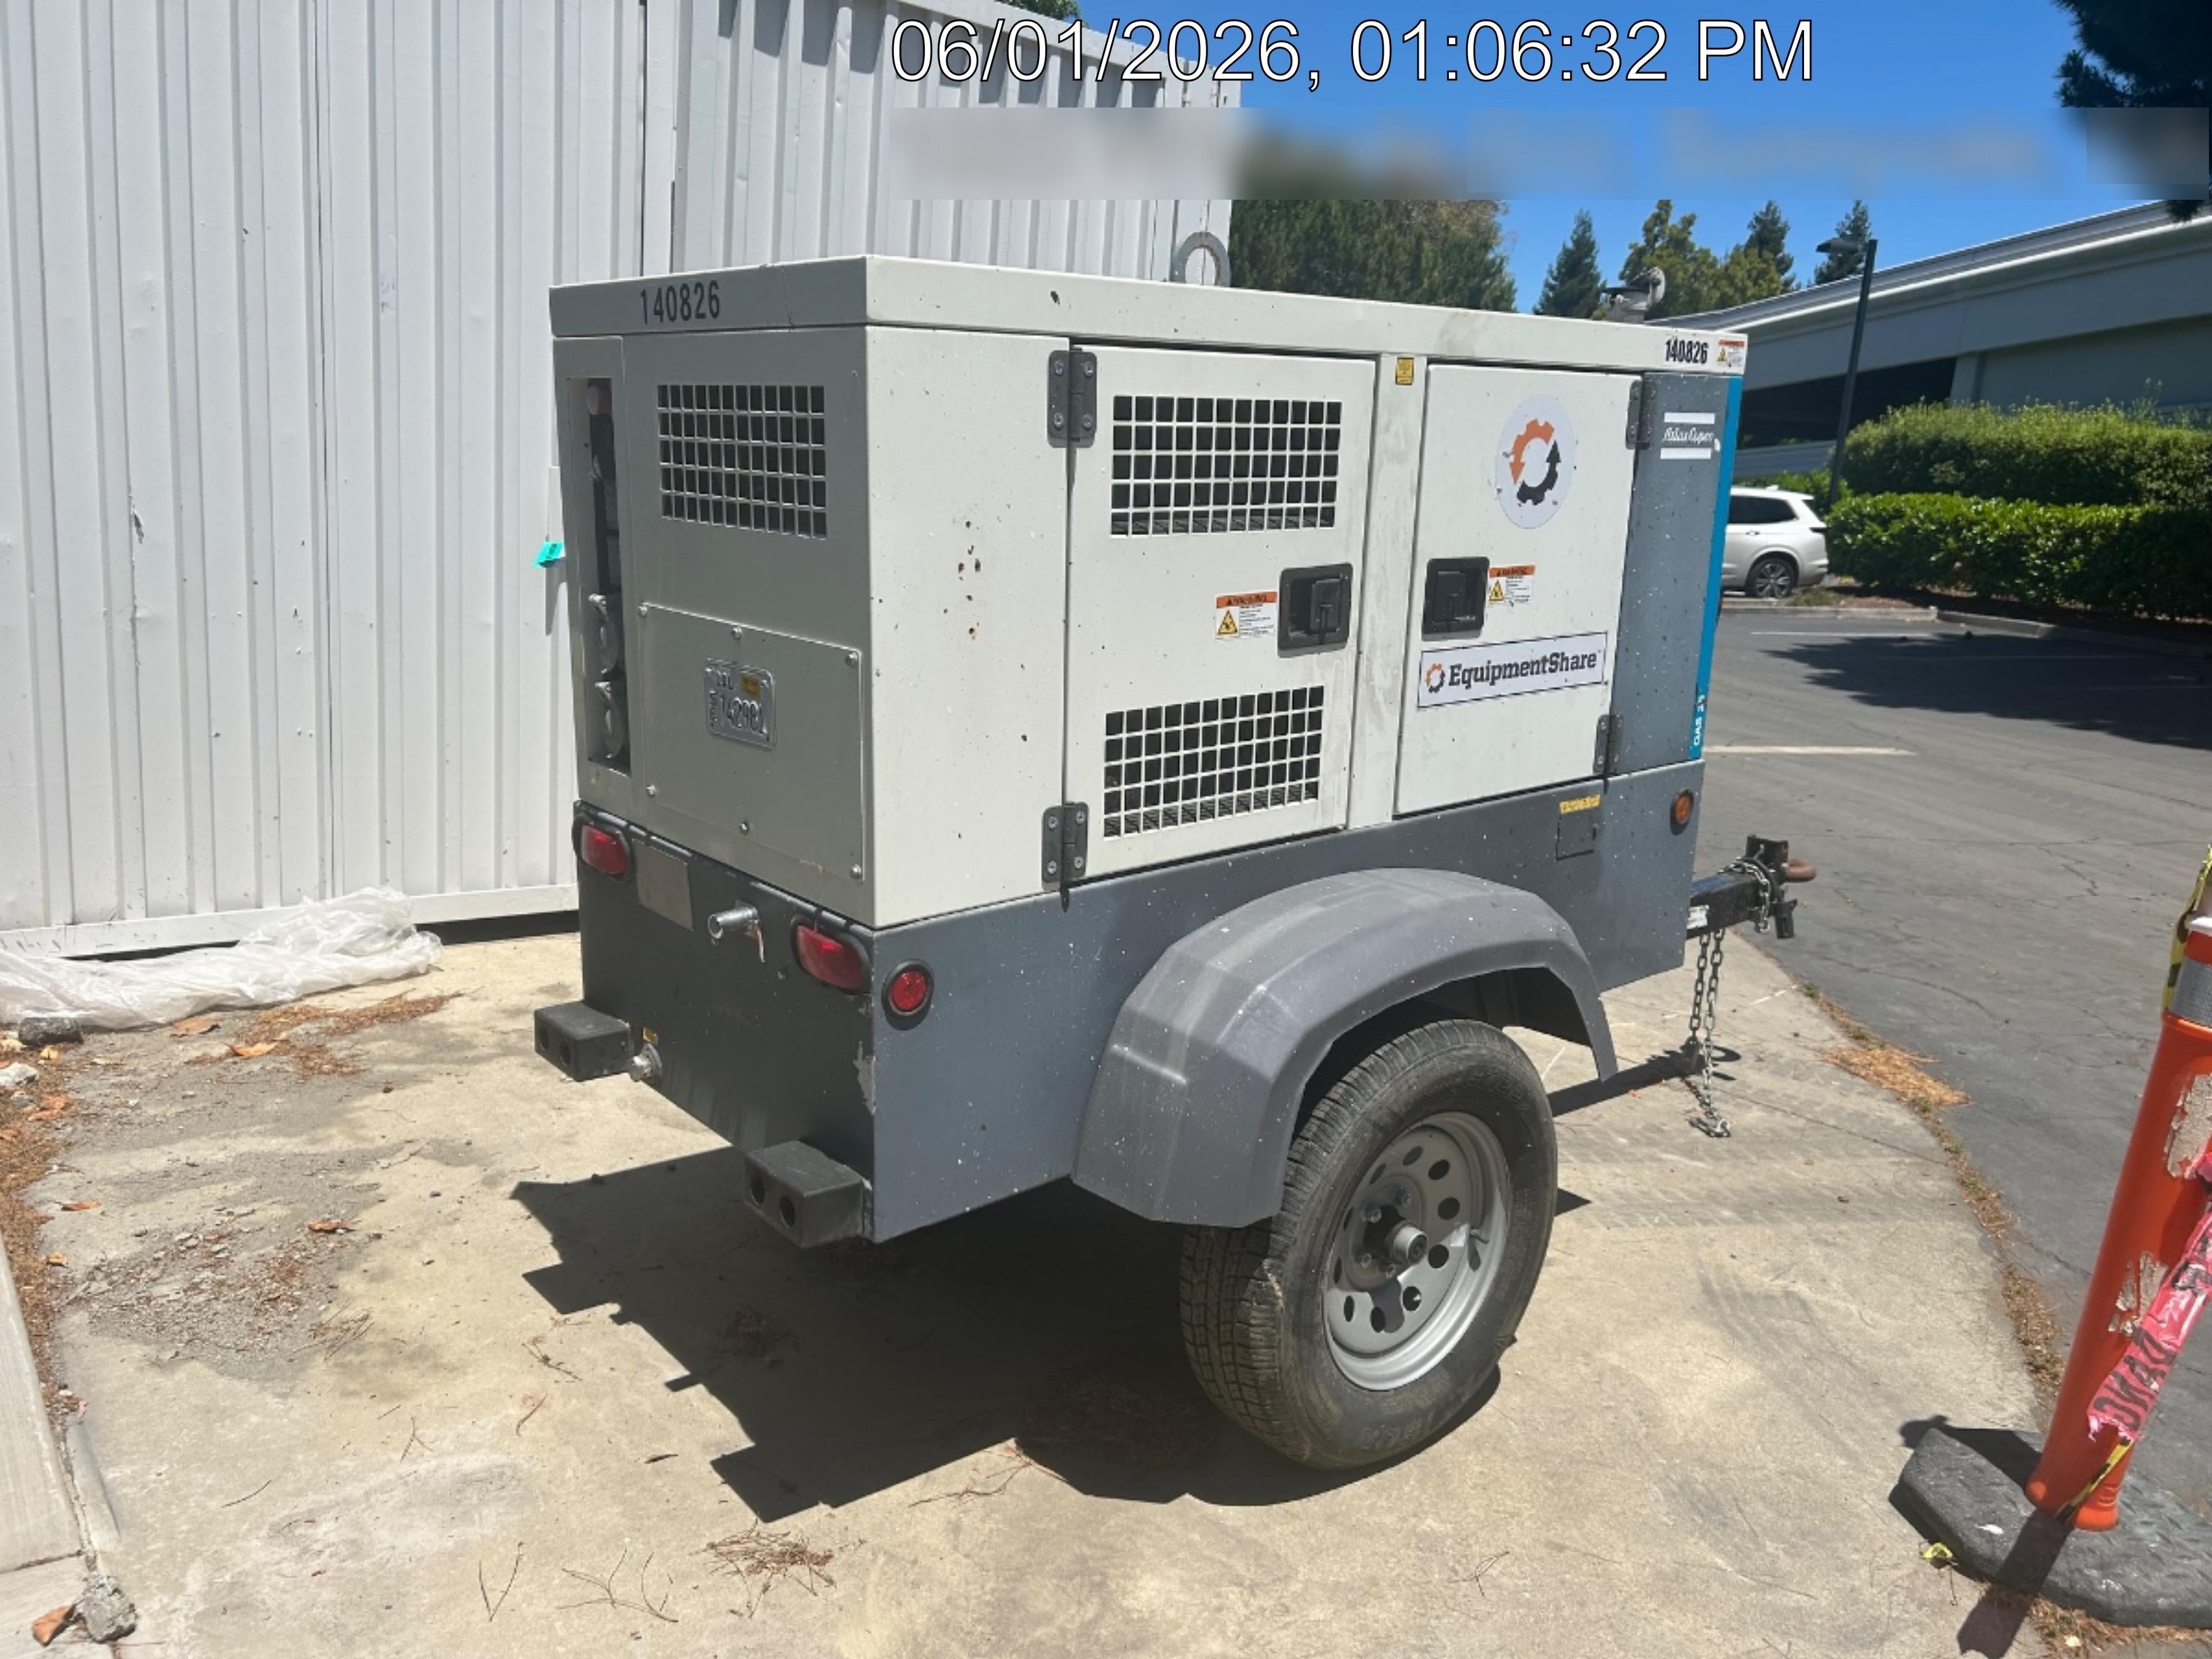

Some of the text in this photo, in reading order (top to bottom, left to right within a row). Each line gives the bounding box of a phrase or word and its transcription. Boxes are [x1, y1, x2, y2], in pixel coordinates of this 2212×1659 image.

[641, 280, 720, 325] 140826
[1666, 337, 1708, 364] 140826
[1448, 651, 1596, 690] EquipmentShare
